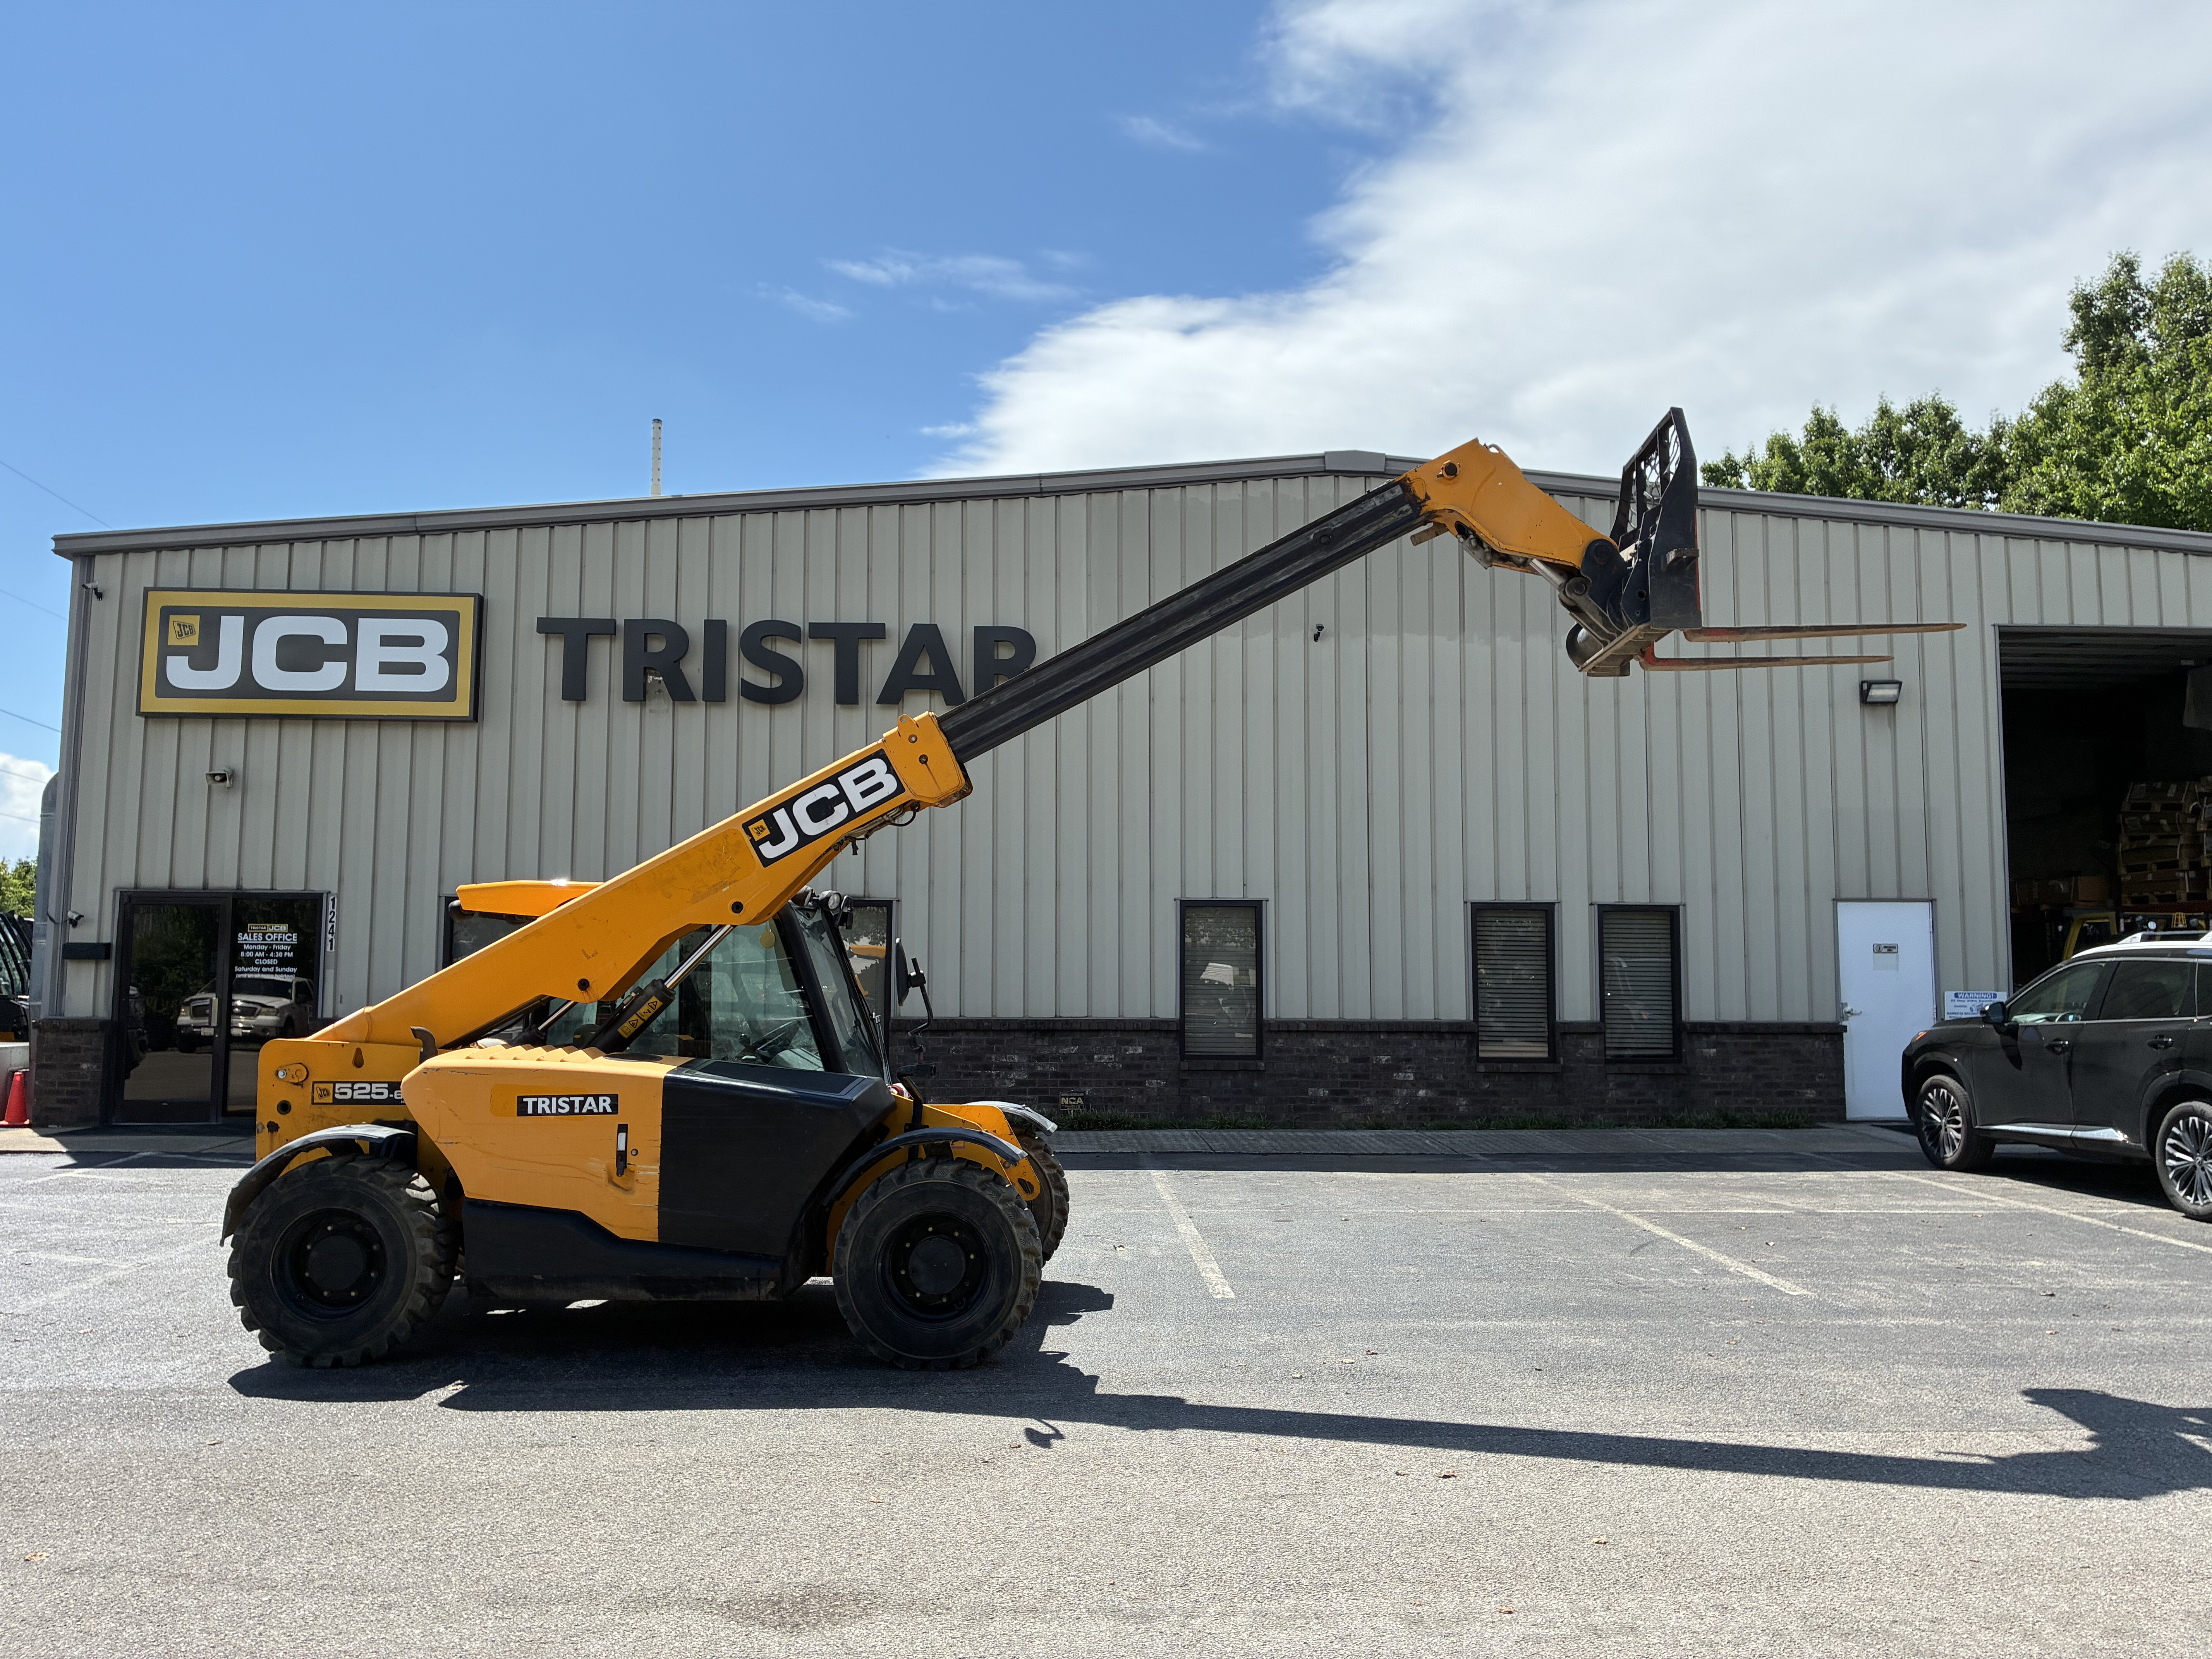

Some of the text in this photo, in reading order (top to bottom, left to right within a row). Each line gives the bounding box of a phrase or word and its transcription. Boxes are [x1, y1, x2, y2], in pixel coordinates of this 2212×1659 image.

[173, 623, 194, 637] JCB
[166, 616, 450, 692] JCB
[537, 617, 1036, 706] TRISTAR
[758, 758, 898, 859] JCB
[237, 933, 297, 941] SALES OFFICE
[523, 1096, 612, 1114] TRISTAR
